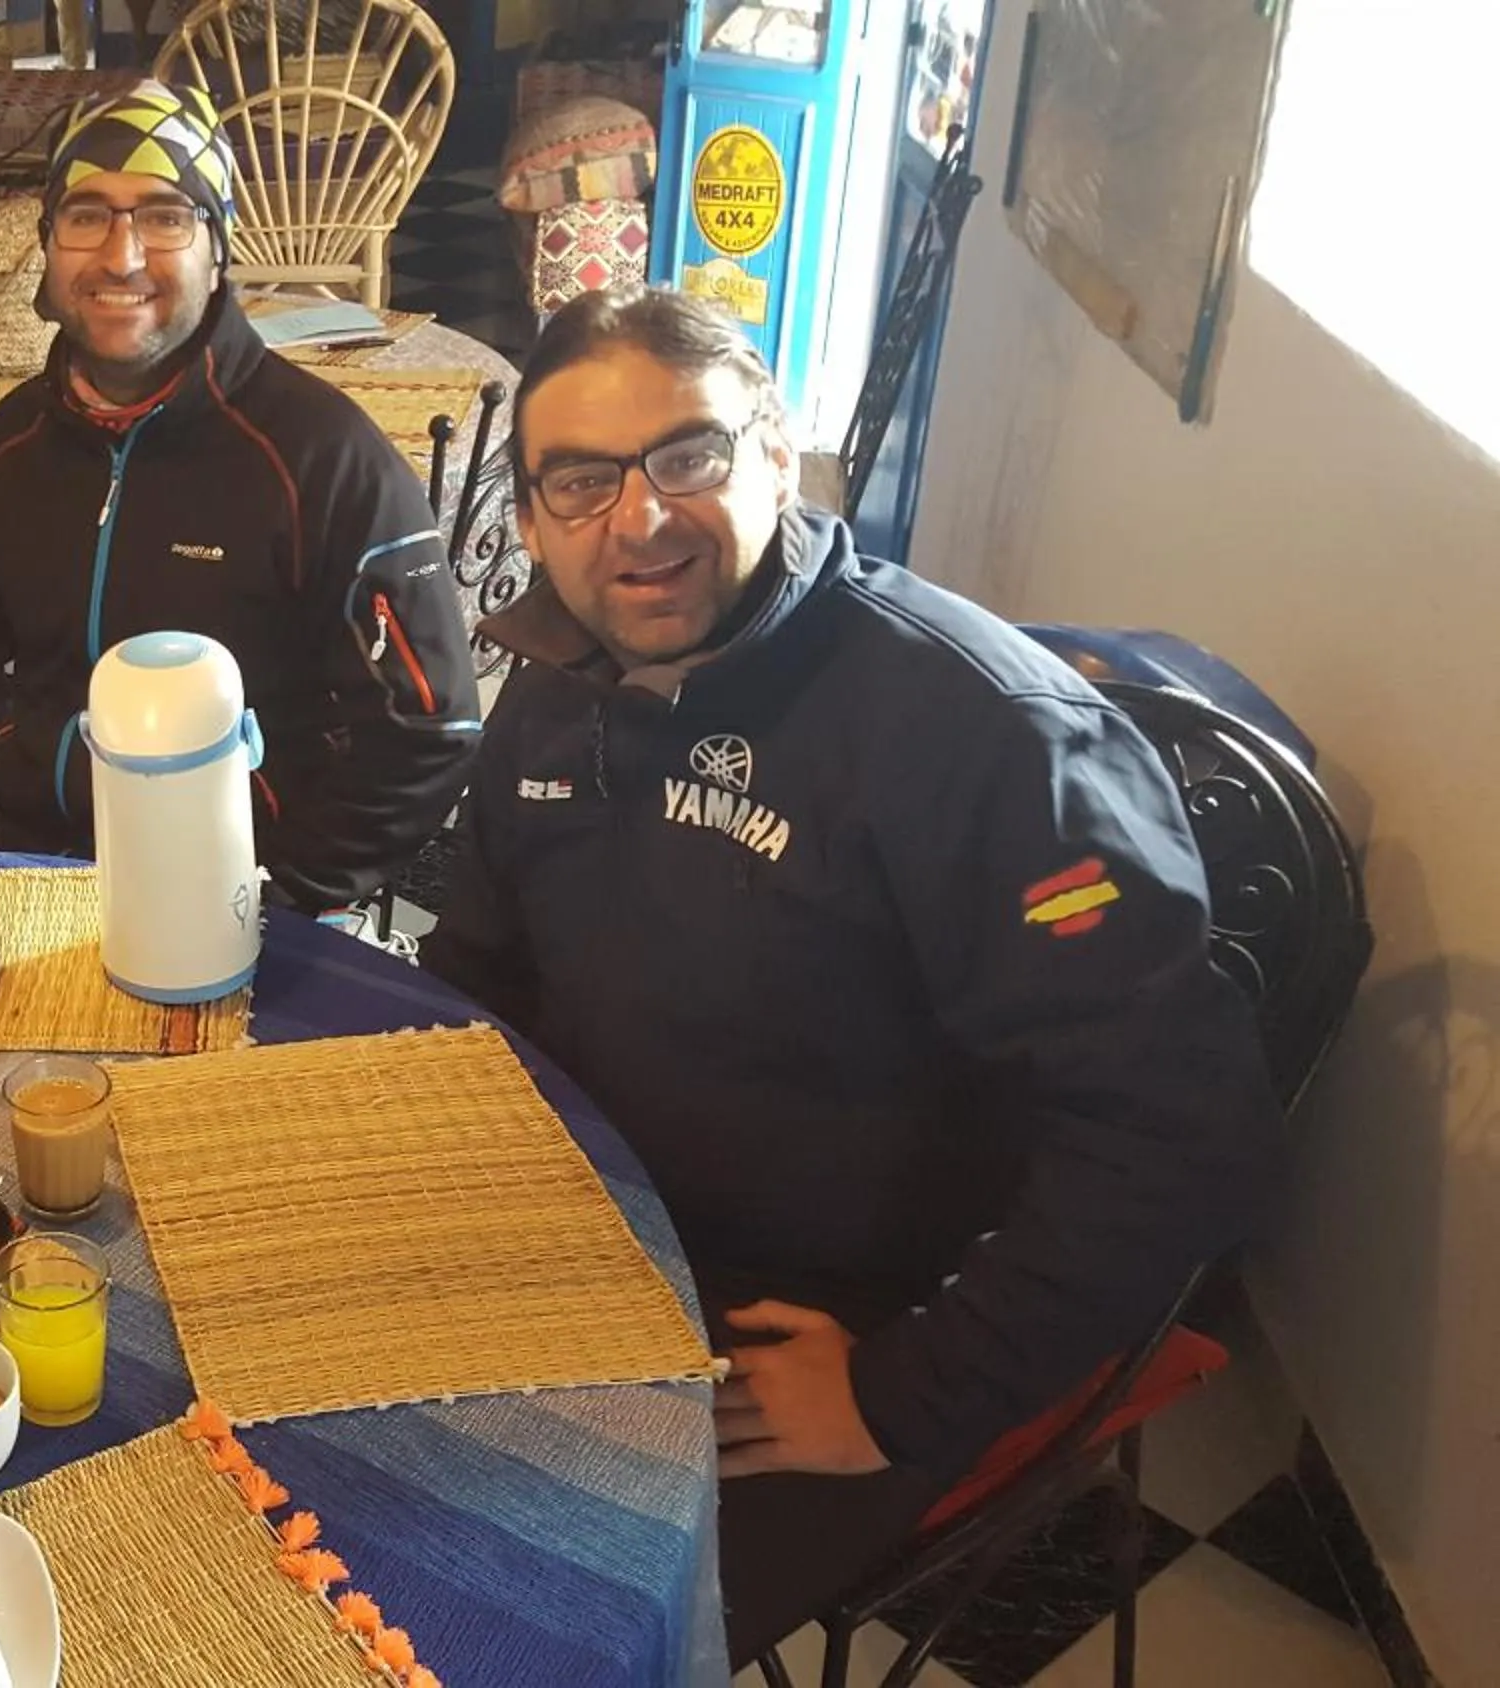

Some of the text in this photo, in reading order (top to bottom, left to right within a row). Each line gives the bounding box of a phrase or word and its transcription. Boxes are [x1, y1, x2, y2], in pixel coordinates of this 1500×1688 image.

[698, 182, 776, 203] MEDRAFT
[714, 209, 755, 229] 4X4
[664, 777, 790, 862] YAMAHA
